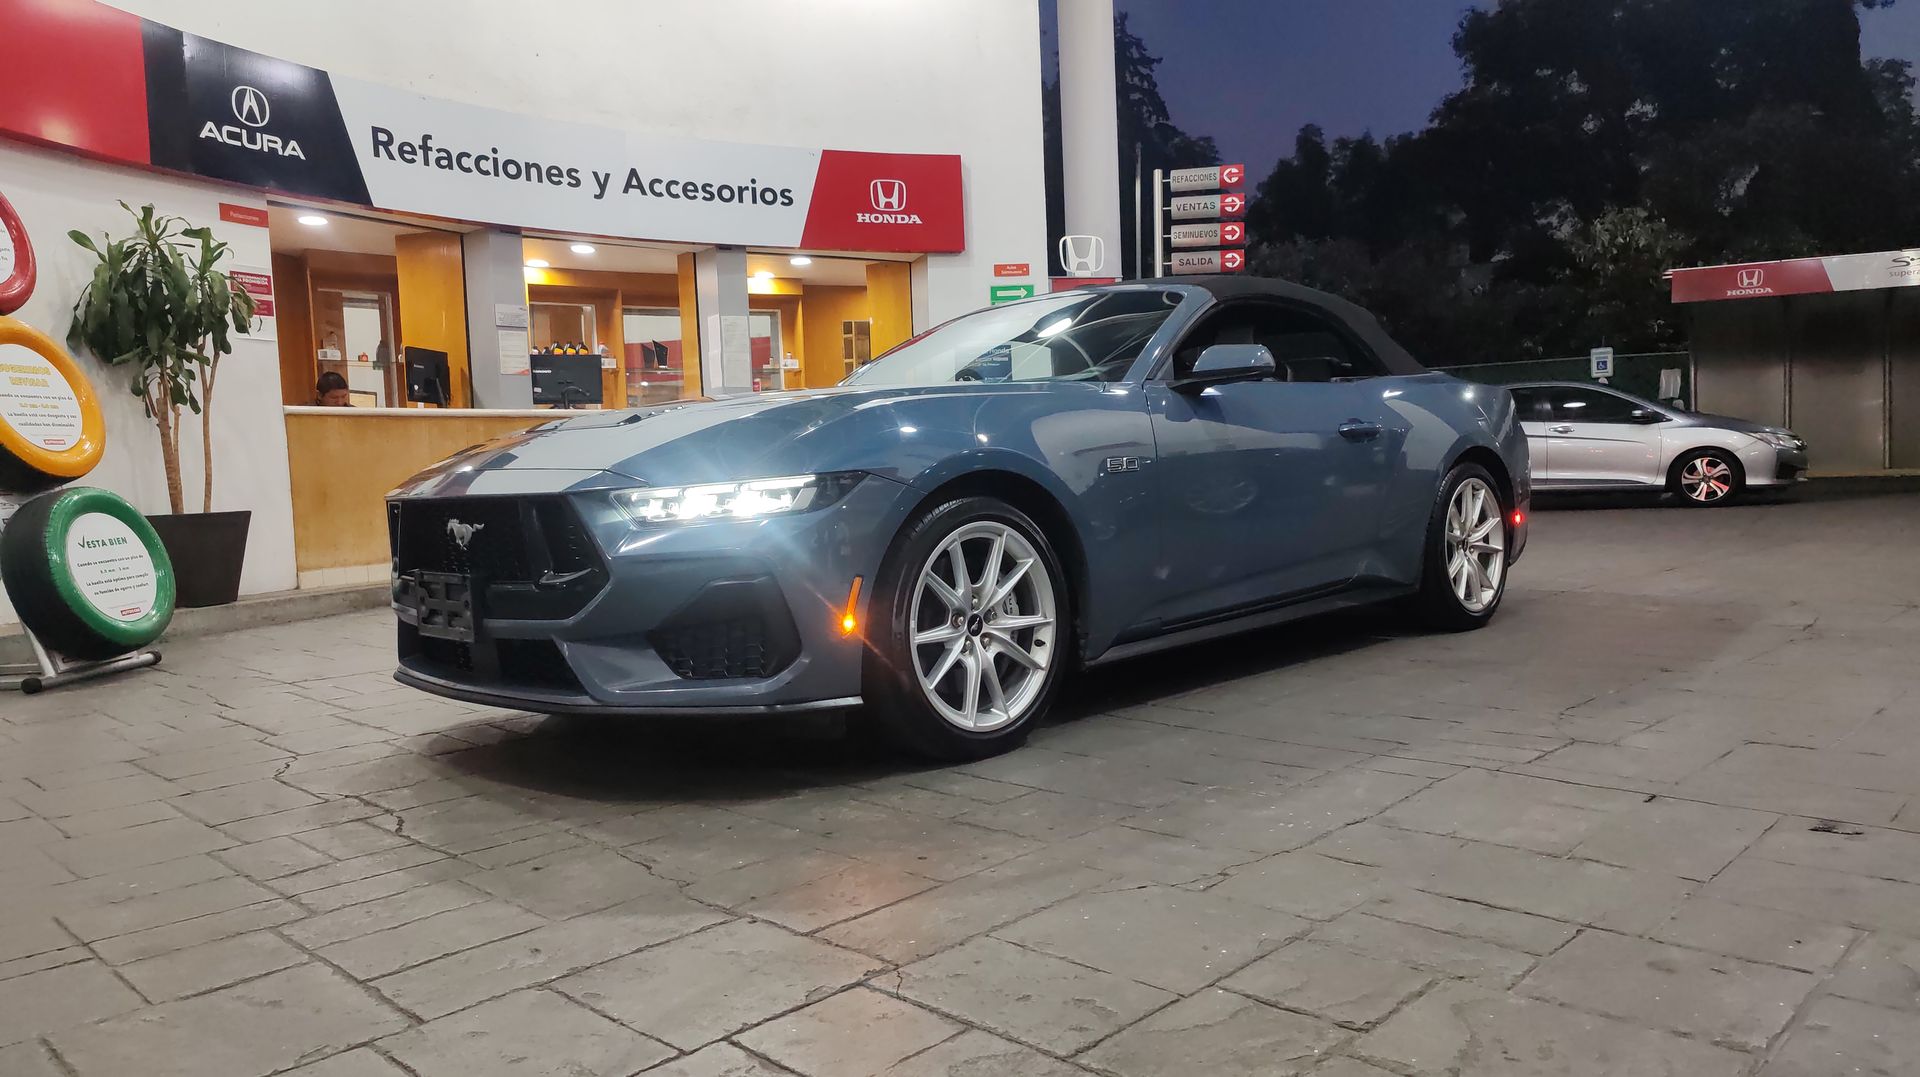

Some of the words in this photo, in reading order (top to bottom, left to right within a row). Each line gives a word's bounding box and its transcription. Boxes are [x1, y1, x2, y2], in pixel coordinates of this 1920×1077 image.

[200, 121, 306, 160] ACURA
[371, 125, 582, 188] Refacciones
[592, 170, 611, 200] y
[622, 167, 794, 207] Accesorios
[1172, 172, 1217, 183] REFACCIONES
[1176, 201, 1216, 212] VENTAS
[856, 213, 922, 224] HONDA
[1173, 229, 1218, 240] SEMINUEVOS
[1178, 257, 1213, 267] SALIDA
[1726, 287, 1773, 296] HONDA
[109, 536, 128, 546] BIEN
